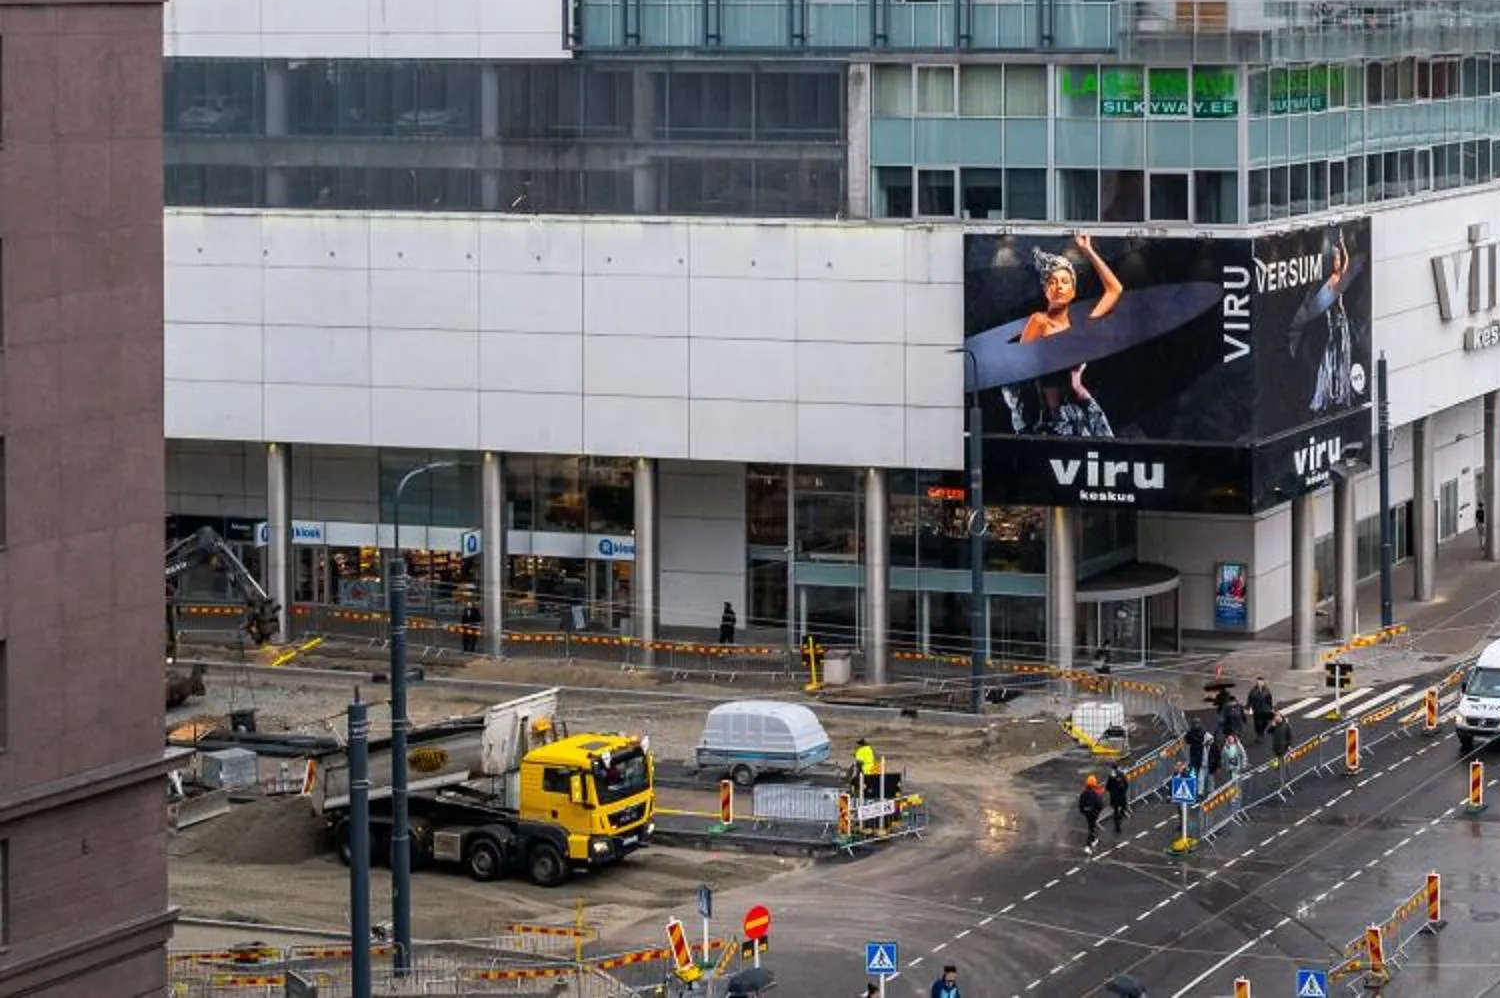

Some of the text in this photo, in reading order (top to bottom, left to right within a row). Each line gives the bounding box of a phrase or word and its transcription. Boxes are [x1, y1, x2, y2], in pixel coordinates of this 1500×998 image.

[1103, 101, 1233, 115] SILKYWAY.EE
[1254, 253, 1323, 295] VERSUM
[1223, 264, 1252, 363] VIRU
[1049, 451, 1165, 489] viru
[1293, 435, 1341, 475] viru
[1079, 489, 1136, 503] keskus
